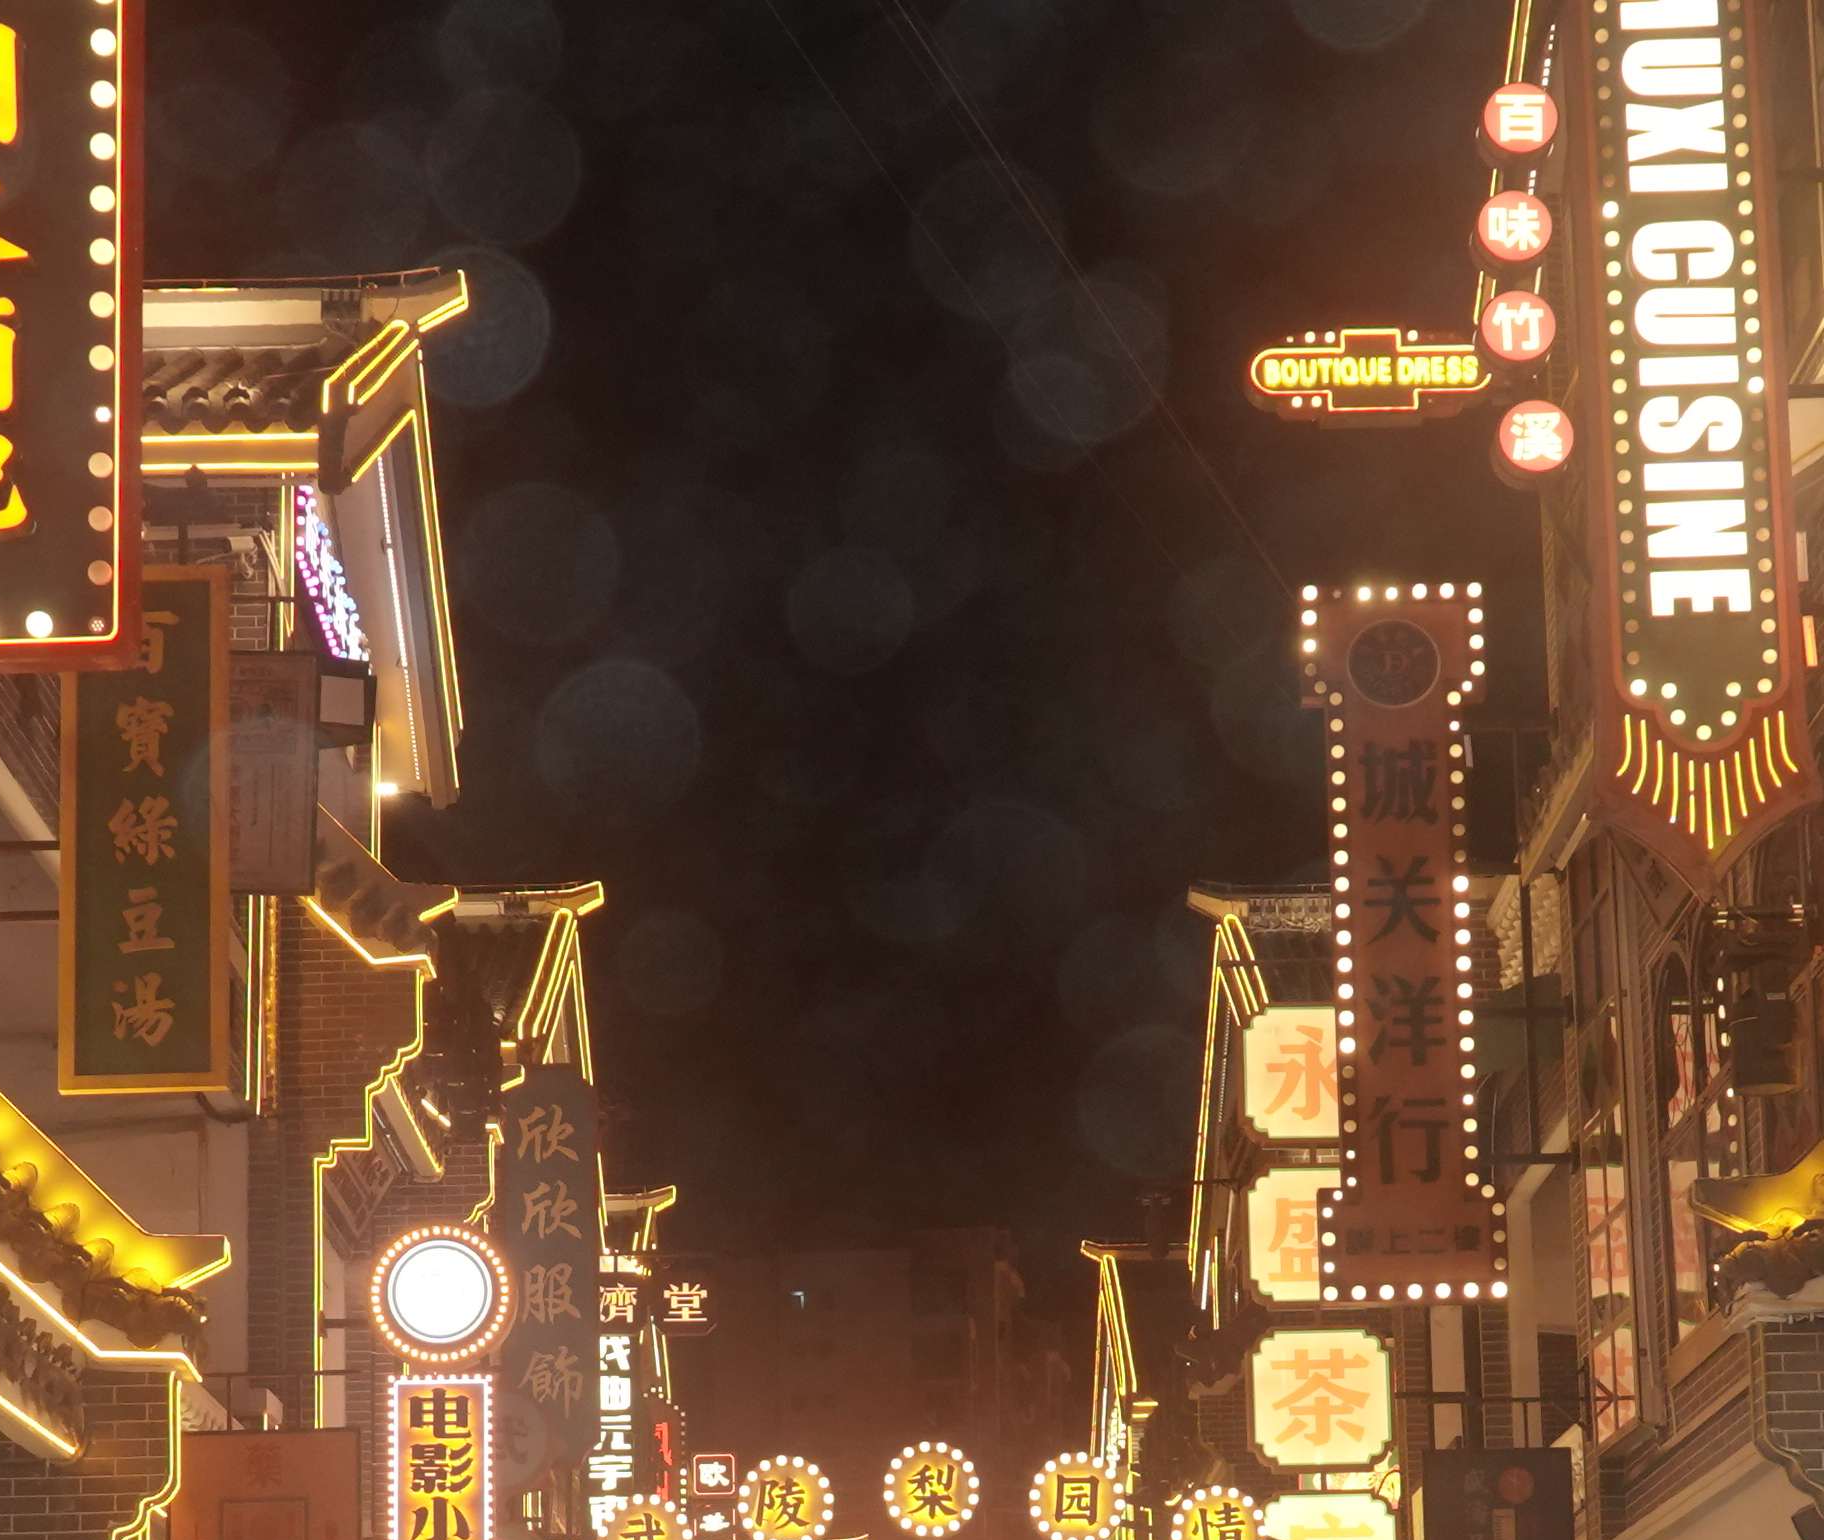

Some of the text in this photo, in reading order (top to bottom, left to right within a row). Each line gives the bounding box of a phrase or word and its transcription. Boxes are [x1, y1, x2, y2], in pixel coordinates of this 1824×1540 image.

[1263, 354, 1481, 388] BOUTIQUE DRESS
[1488, 92, 1566, 462] 百味竹溪
[1628, 218, 1753, 619] CUISINE
[1357, 738, 1452, 1190] 城关洋行
[516, 1104, 584, 1420] 欣欣服飾
